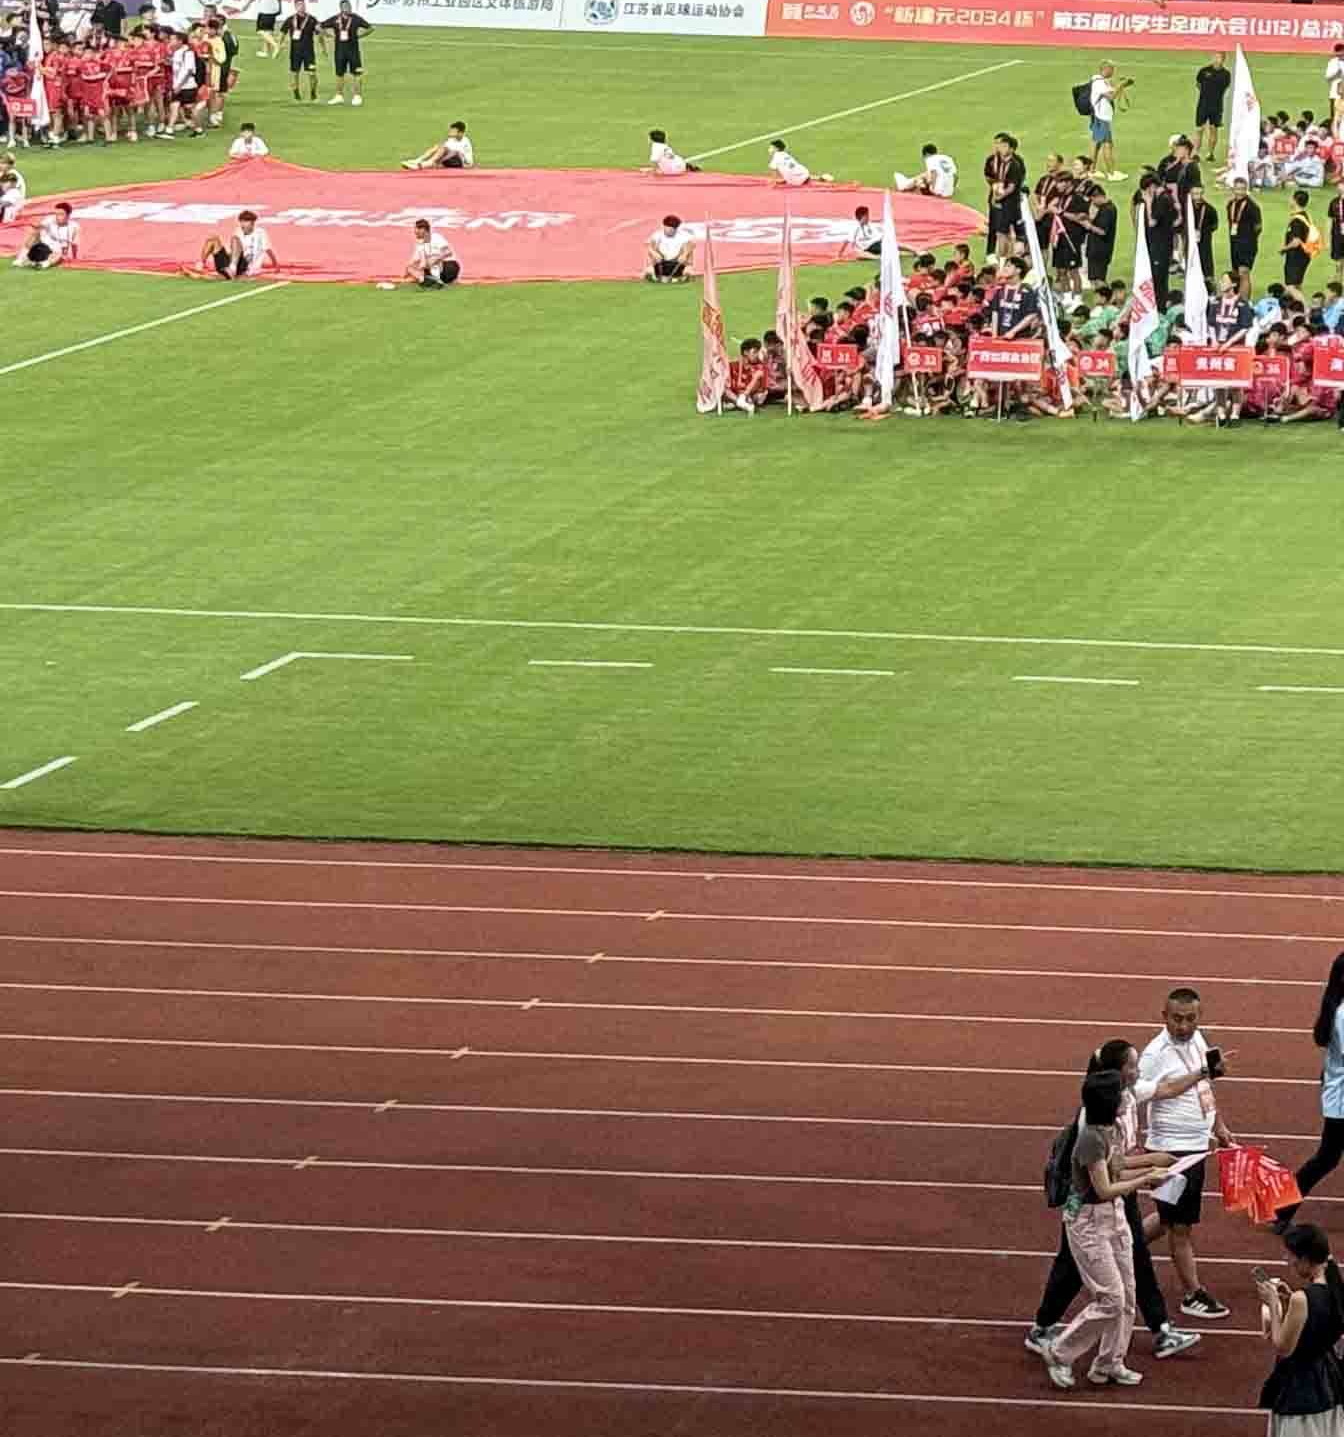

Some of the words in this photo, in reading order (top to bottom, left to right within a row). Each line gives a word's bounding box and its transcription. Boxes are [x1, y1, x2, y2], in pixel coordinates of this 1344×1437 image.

[623, 1, 745, 19] 江苏省足球运动协会
[1196, 357, 1236, 372] 贵州省
